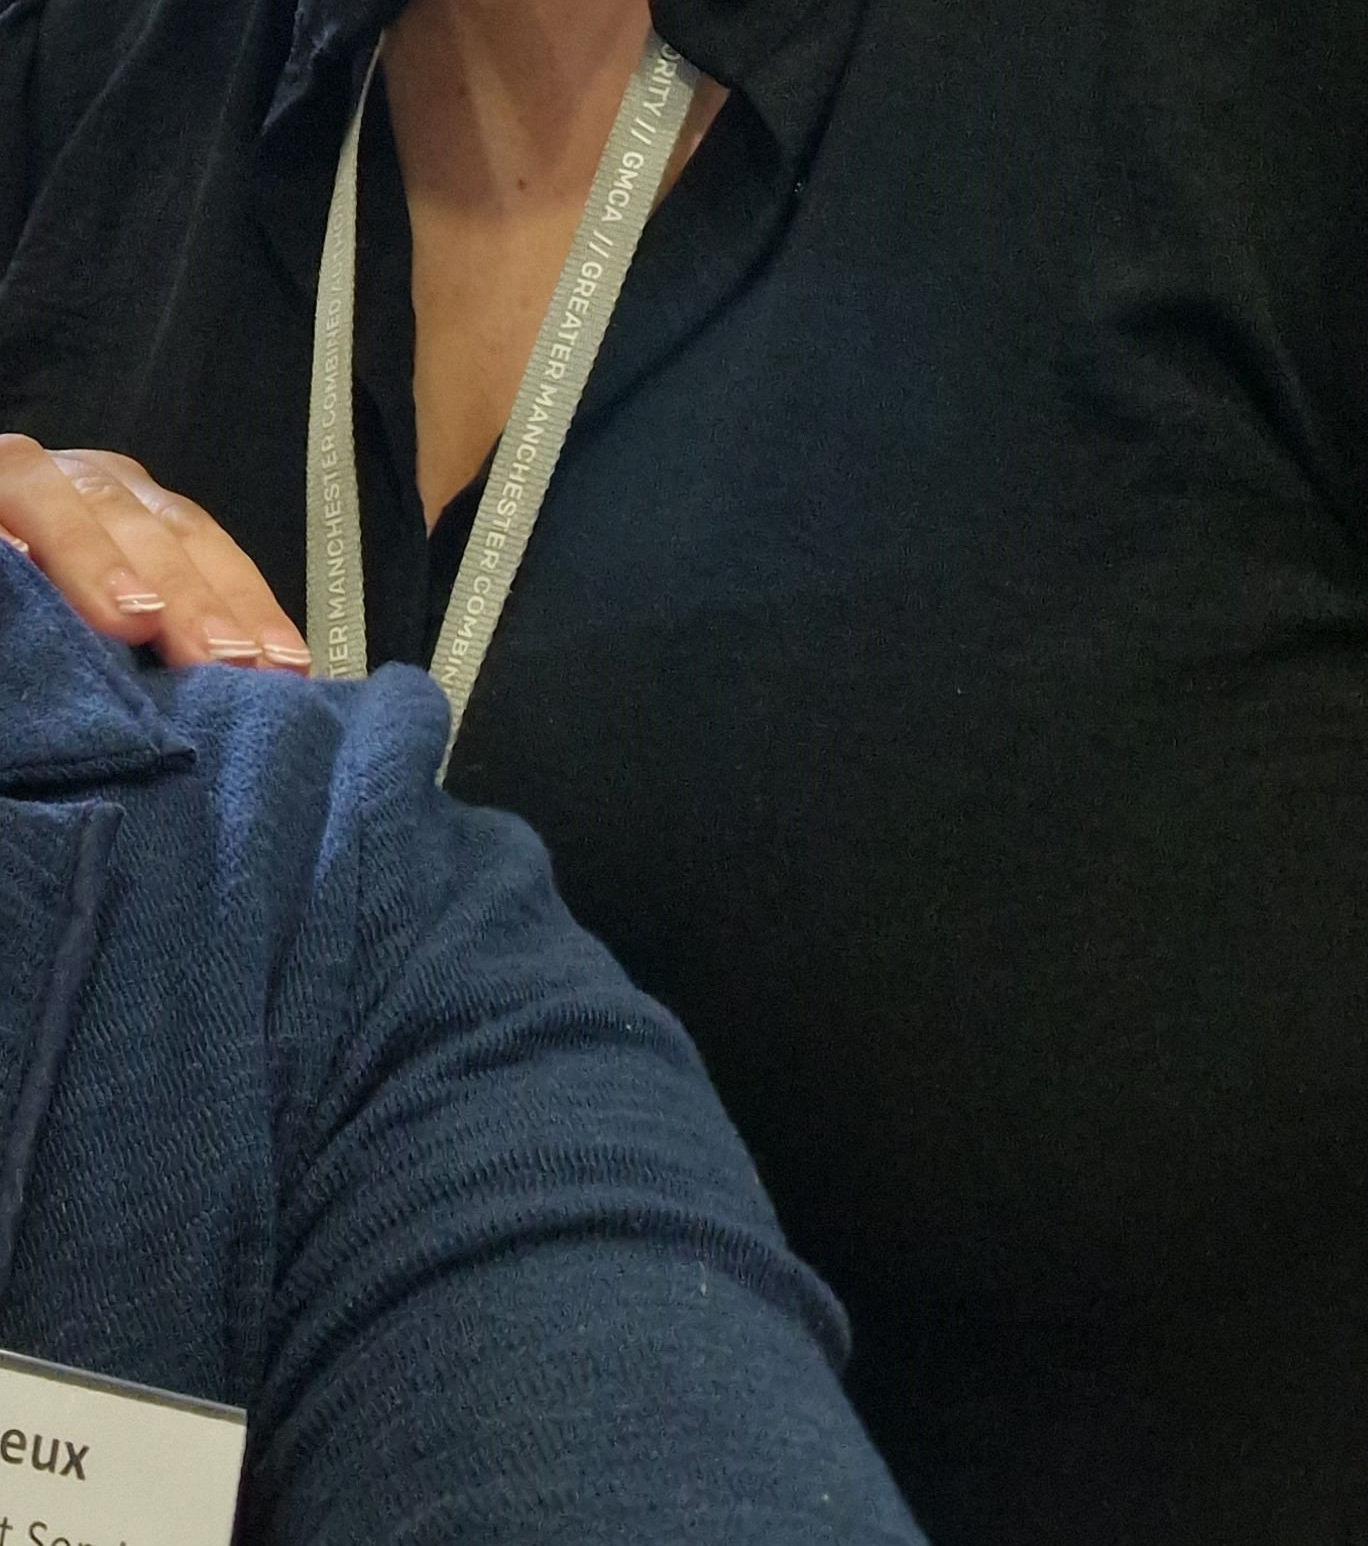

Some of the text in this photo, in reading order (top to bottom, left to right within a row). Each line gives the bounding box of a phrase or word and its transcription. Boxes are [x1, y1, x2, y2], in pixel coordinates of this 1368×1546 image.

[601, 151, 644, 223] GMCA
[544, 261, 603, 380] GREATER
[321, 434, 347, 621] MANCHESTER
[480, 383, 557, 570] MANCHESTER
[441, 575, 491, 695] COMBIN
